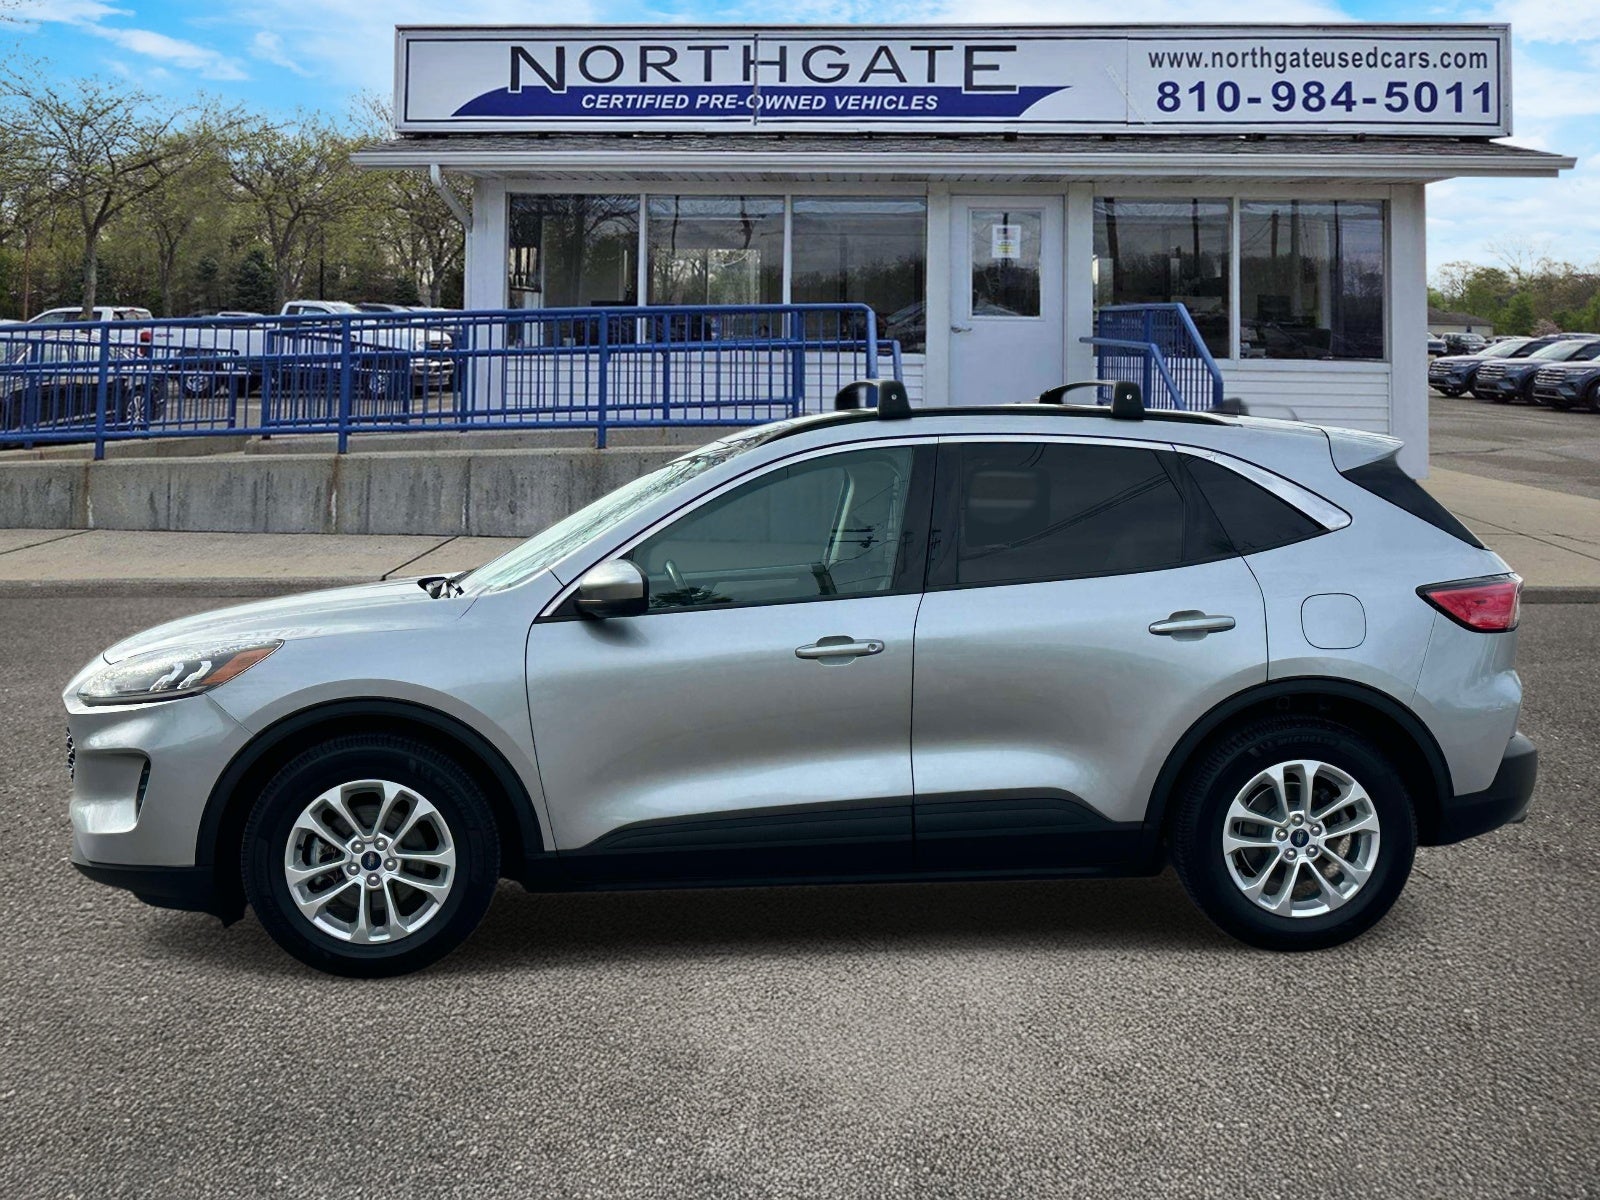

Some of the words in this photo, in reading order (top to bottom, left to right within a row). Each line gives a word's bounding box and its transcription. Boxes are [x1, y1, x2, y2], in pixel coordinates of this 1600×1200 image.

[510, 44, 1017, 92] NORTHGATE
[1148, 46, 1488, 74] www.northgateusedcars.com
[581, 94, 689, 109] CERTIFIED
[695, 94, 827, 110] PRE-OWNED
[834, 95, 938, 110] VEHICLES
[1156, 80, 1490, 114] 810-984-5011
